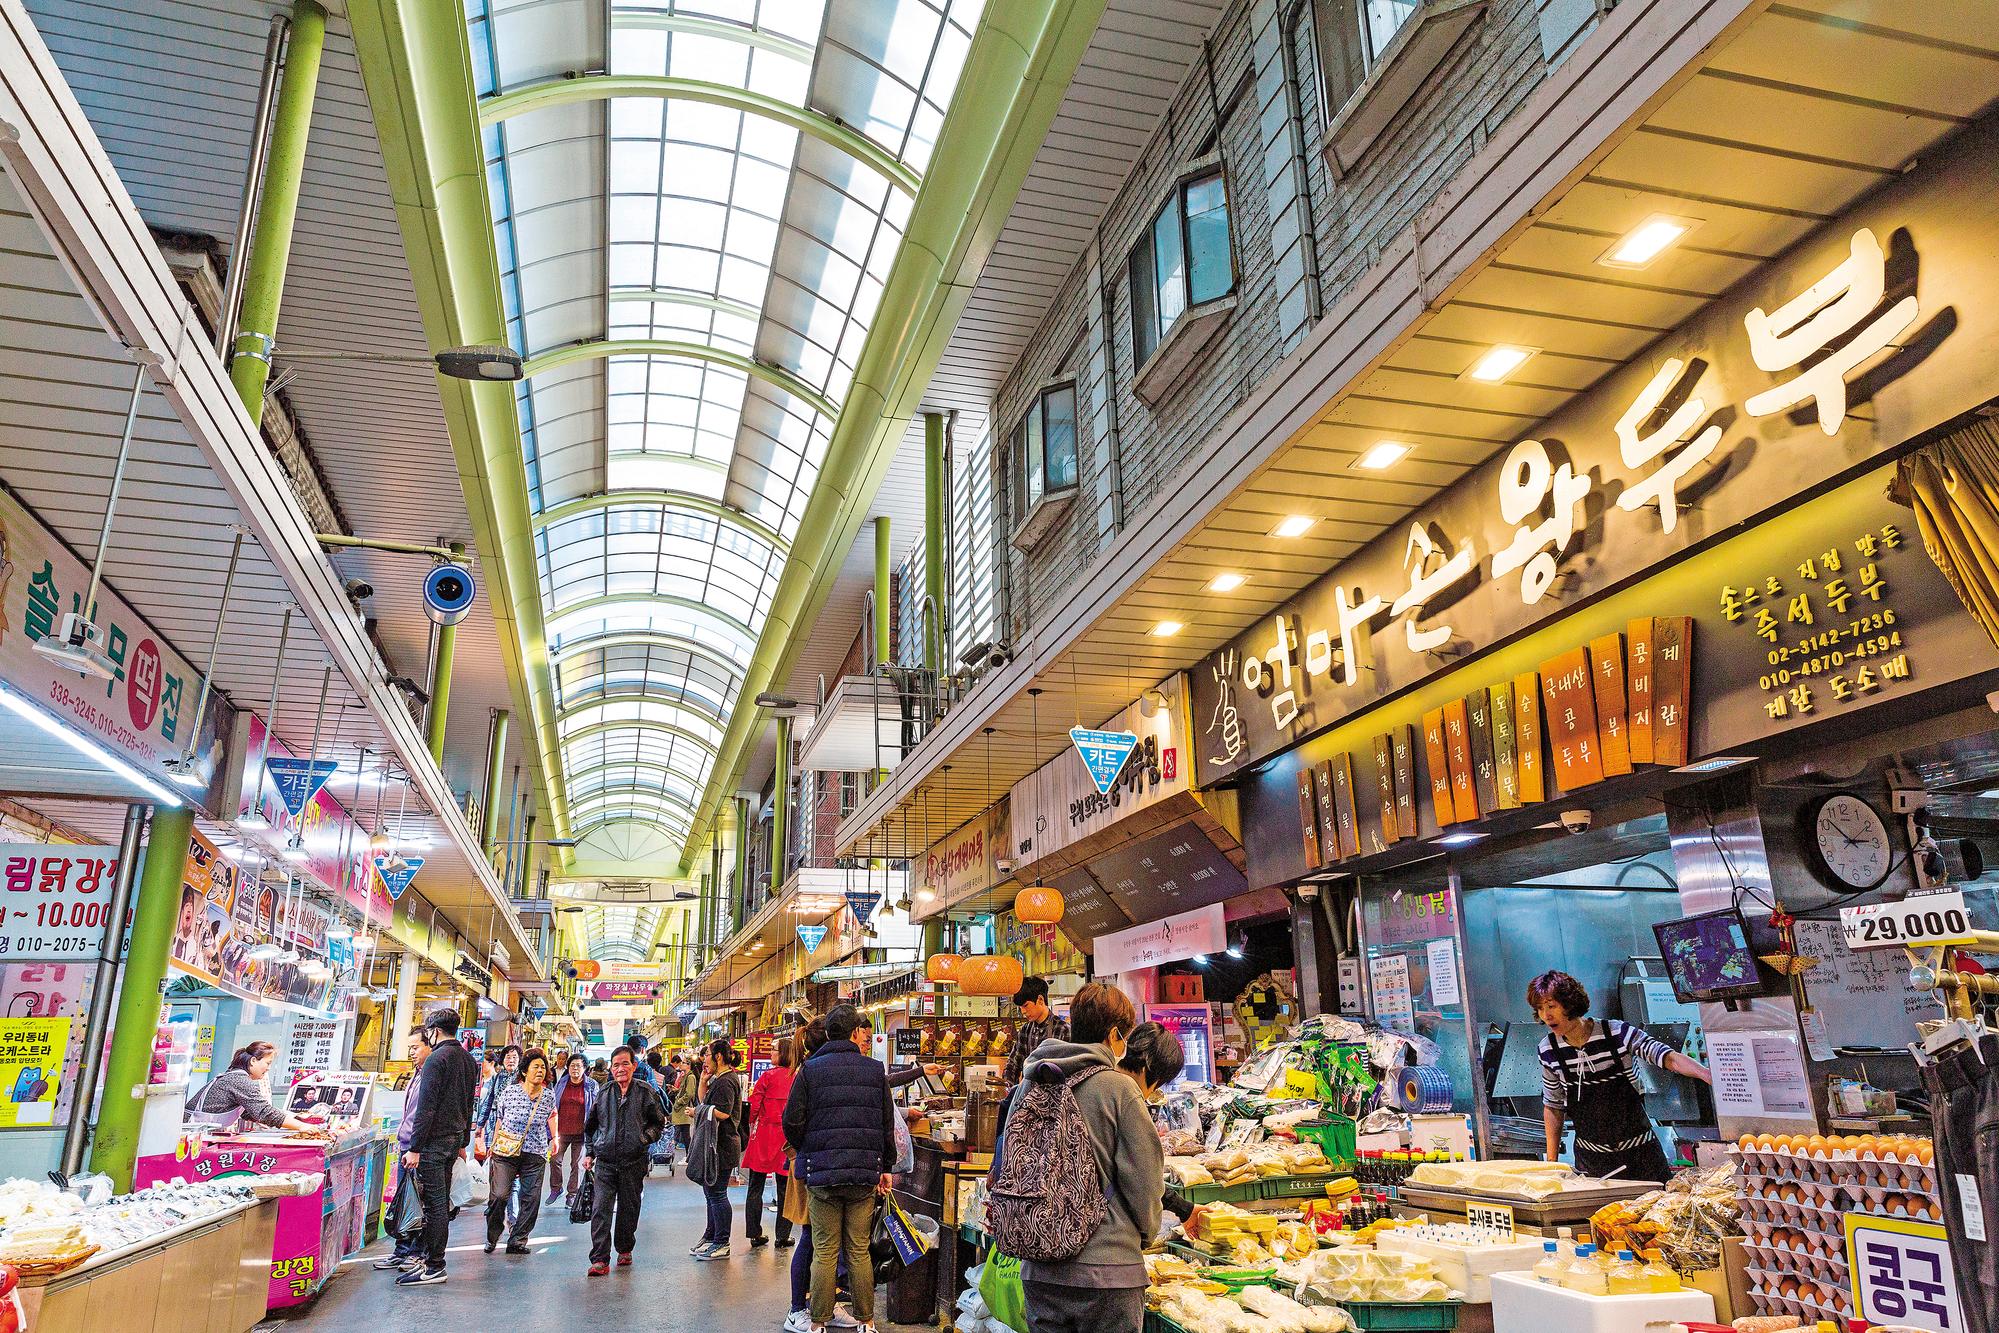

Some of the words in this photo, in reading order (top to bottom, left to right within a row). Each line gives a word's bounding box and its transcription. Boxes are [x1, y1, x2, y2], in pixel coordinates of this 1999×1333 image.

[1720, 576, 1782, 621] 손으로
[1797, 548, 1841, 579] 직접
[1855, 524, 1900, 557] 만든
[1768, 609, 1896, 665] 02-3142-7236
[1759, 631, 1902, 690] 010-4870-4594
[1546, 669, 1586, 698] 국내산
[1633, 641, 1650, 726] 콩비지
[1661, 644, 1679, 727] 계란
[1602, 658, 1620, 738] 두부
[1764, 684, 1813, 718] 계란
[1564, 706, 1577, 731] 콩
[1520, 693, 1533, 769] 순두부
[1450, 718, 1468, 792] 청국장
[1472, 708, 1491, 780] 된장
[1496, 695, 1515, 797] 도토리묵
[1089, 749, 1118, 766] 카드
[1428, 727, 1447, 793] 식혜
[1561, 746, 1591, 767] 두부
[1396, 743, 1409, 807] 만두피
[1301, 784, 1313, 839] 냉면
[1826, 807, 1836, 818] 11
[1838, 803, 1849, 815] 12
[1855, 809, 1859, 820] 1
[1818, 818, 1830, 831] 10
[1864, 820, 1872, 832] 2
[1819, 834, 1827, 846] 9
[1872, 837, 1880, 849] 3
[1826, 850, 1834, 862] 8
[1870, 853, 1878, 864] 4
[1838, 863, 1845, 875] 7
[1852, 868, 1860, 881] 6
[1863, 865, 1871, 877] 5
[3, 1032, 49, 1043] 우리동네
[0, 1045, 51, 1057] 오케스트라
[271, 1255, 315, 1279] 강정
[1867, 1243, 1949, 1328] 콩국
